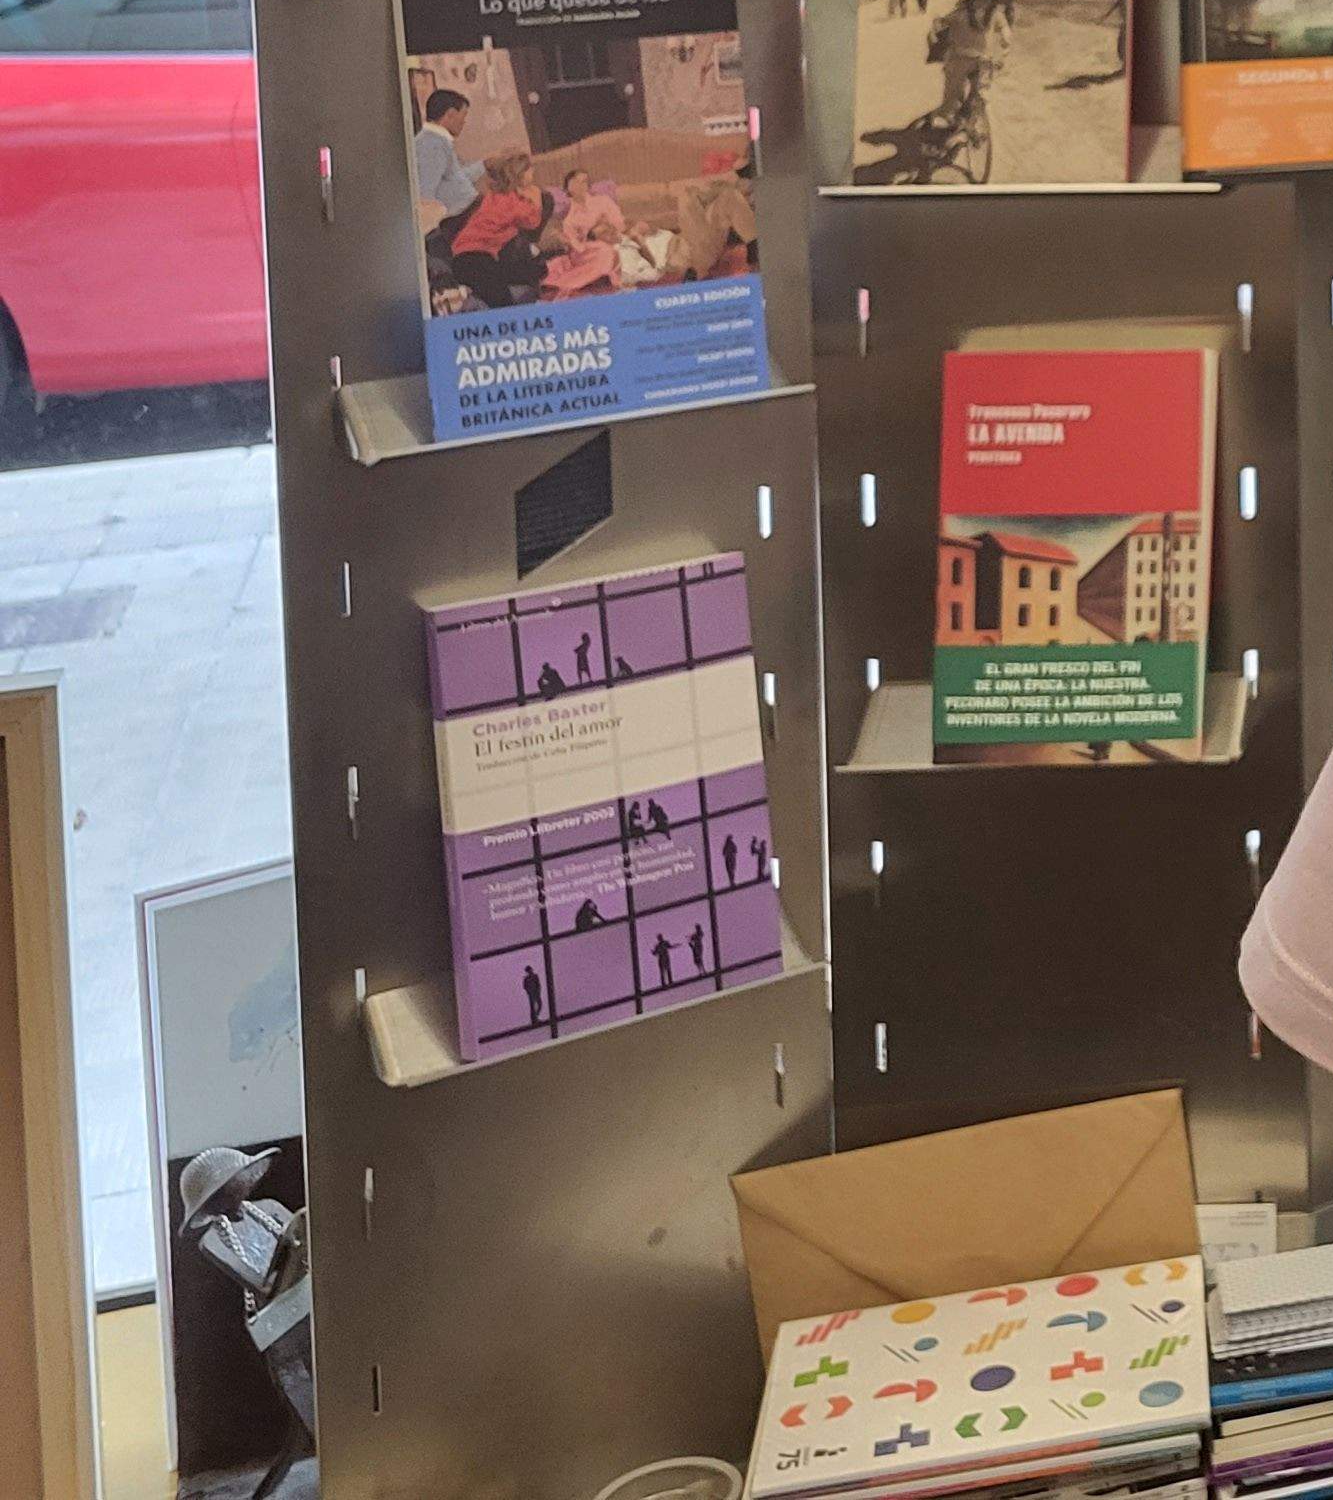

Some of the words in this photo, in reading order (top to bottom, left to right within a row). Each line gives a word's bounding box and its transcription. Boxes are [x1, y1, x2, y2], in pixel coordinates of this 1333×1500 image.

[453, 321, 492, 341] UNA
[498, 319, 518, 337] DE
[523, 316, 555, 334] LAS
[455, 333, 558, 366] AUTORAS
[563, 323, 611, 350] MÁS
[458, 347, 613, 391] ADMIRADAS
[459, 391, 483, 410] DE
[487, 388, 509, 406] LA
[513, 373, 610, 402] LITERATURA
[461, 401, 553, 429] BRITÁNICA
[473, 714, 542, 737] Charles
[547, 702, 607, 722] Baxter
[475, 738, 492, 757] El
[549, 722, 575, 742] del
[578, 715, 623, 736] amor
